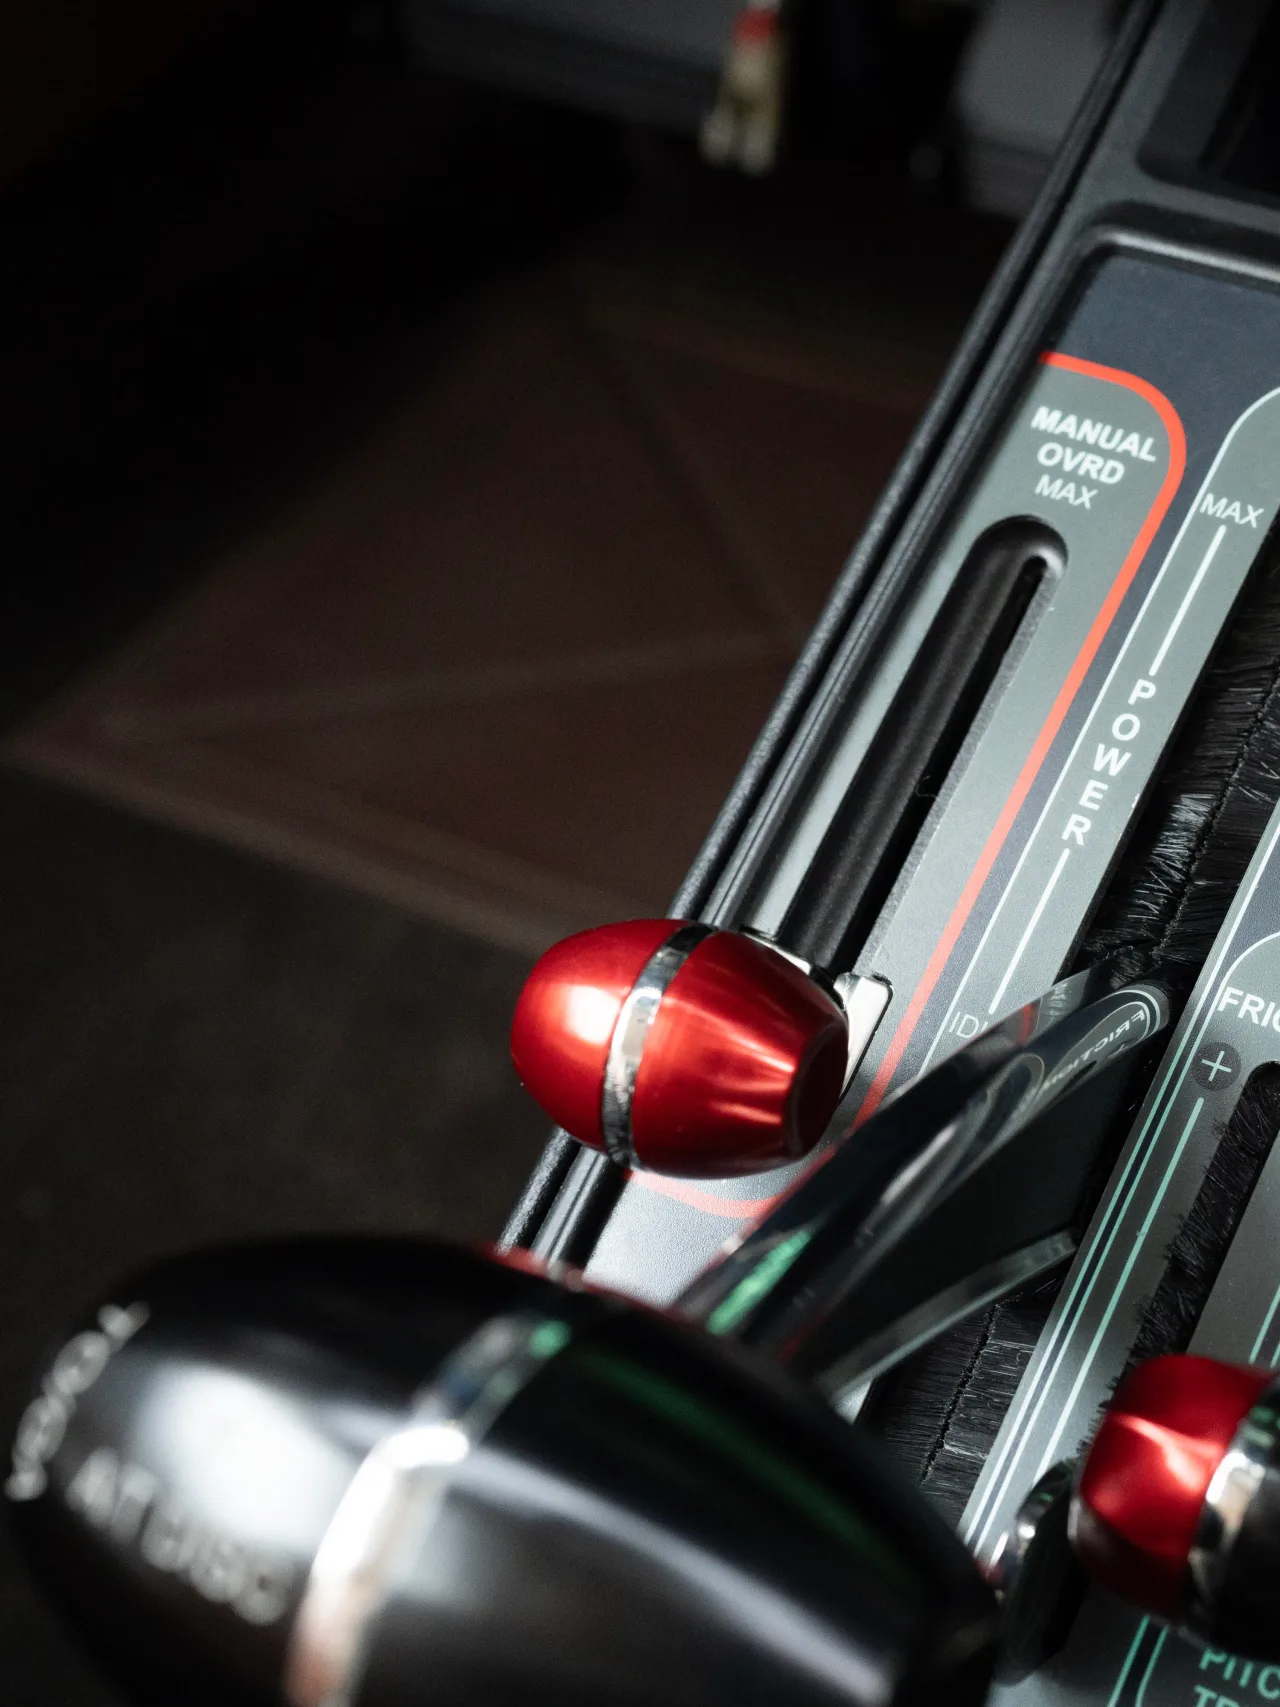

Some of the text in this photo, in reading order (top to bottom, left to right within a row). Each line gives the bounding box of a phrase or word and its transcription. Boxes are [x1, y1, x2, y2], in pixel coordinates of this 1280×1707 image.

[1030, 405, 1157, 463] MANUAL
[1036, 441, 1126, 485] OVRD
[1034, 474, 1098, 509] MAX
[1198, 493, 1265, 528] MAX
[1060, 678, 1158, 846] POWER
